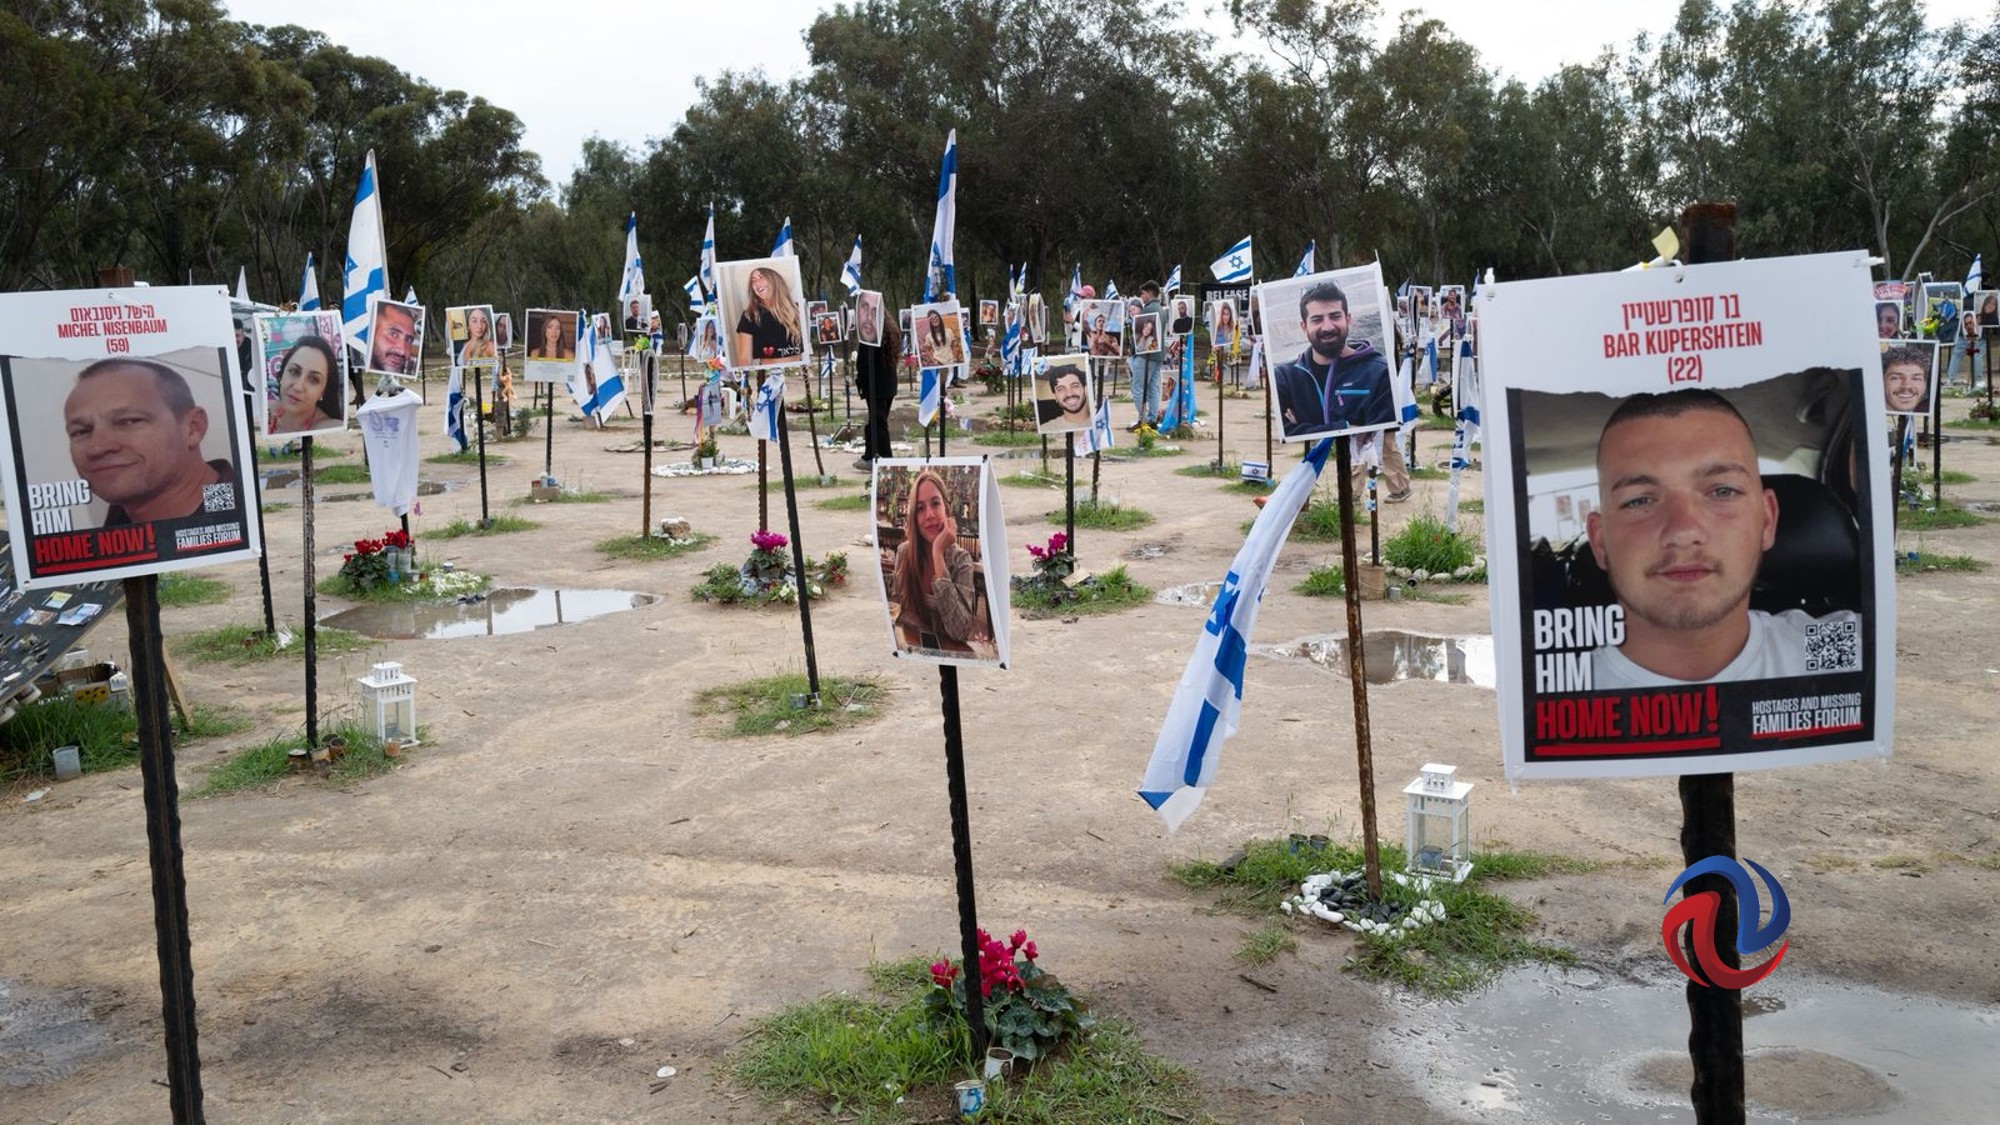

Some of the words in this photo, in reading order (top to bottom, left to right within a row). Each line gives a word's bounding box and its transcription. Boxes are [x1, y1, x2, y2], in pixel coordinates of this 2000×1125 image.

[70, 306, 122, 322] ניסנבאום
[124, 304, 155, 319] מישל
[1621, 296, 1715, 331] קופרשטיין
[1719, 293, 1741, 319] בר
[57, 323, 101, 339] MICHEL
[102, 319, 168, 336] NISENBAUM
[1603, 332, 1641, 359] BAR
[1645, 321, 1763, 355] KUPERSHTEIN
[106, 337, 130, 354] (59)
[1667, 354, 1703, 385] (22)
[27, 480, 91, 509] BRING
[31, 508, 73, 536] HIM
[34, 534, 93, 564] HOME
[97, 521, 156, 555] NOW!
[176, 533, 213, 549] FAMILIES
[213, 530, 241, 544] FORUM
[1533, 603, 1626, 650] BRING
[1535, 651, 1593, 694] HIM
[1535, 696, 1622, 740] HOME
[1629, 685, 1719, 736] NOW!
[1751, 698, 1799, 715] HOSTAGES
[1800, 696, 1820, 710] AND
[1820, 692, 1862, 708] MISSING
[1753, 710, 1812, 735] FAMILIES
[1814, 706, 1861, 729] FORUM
